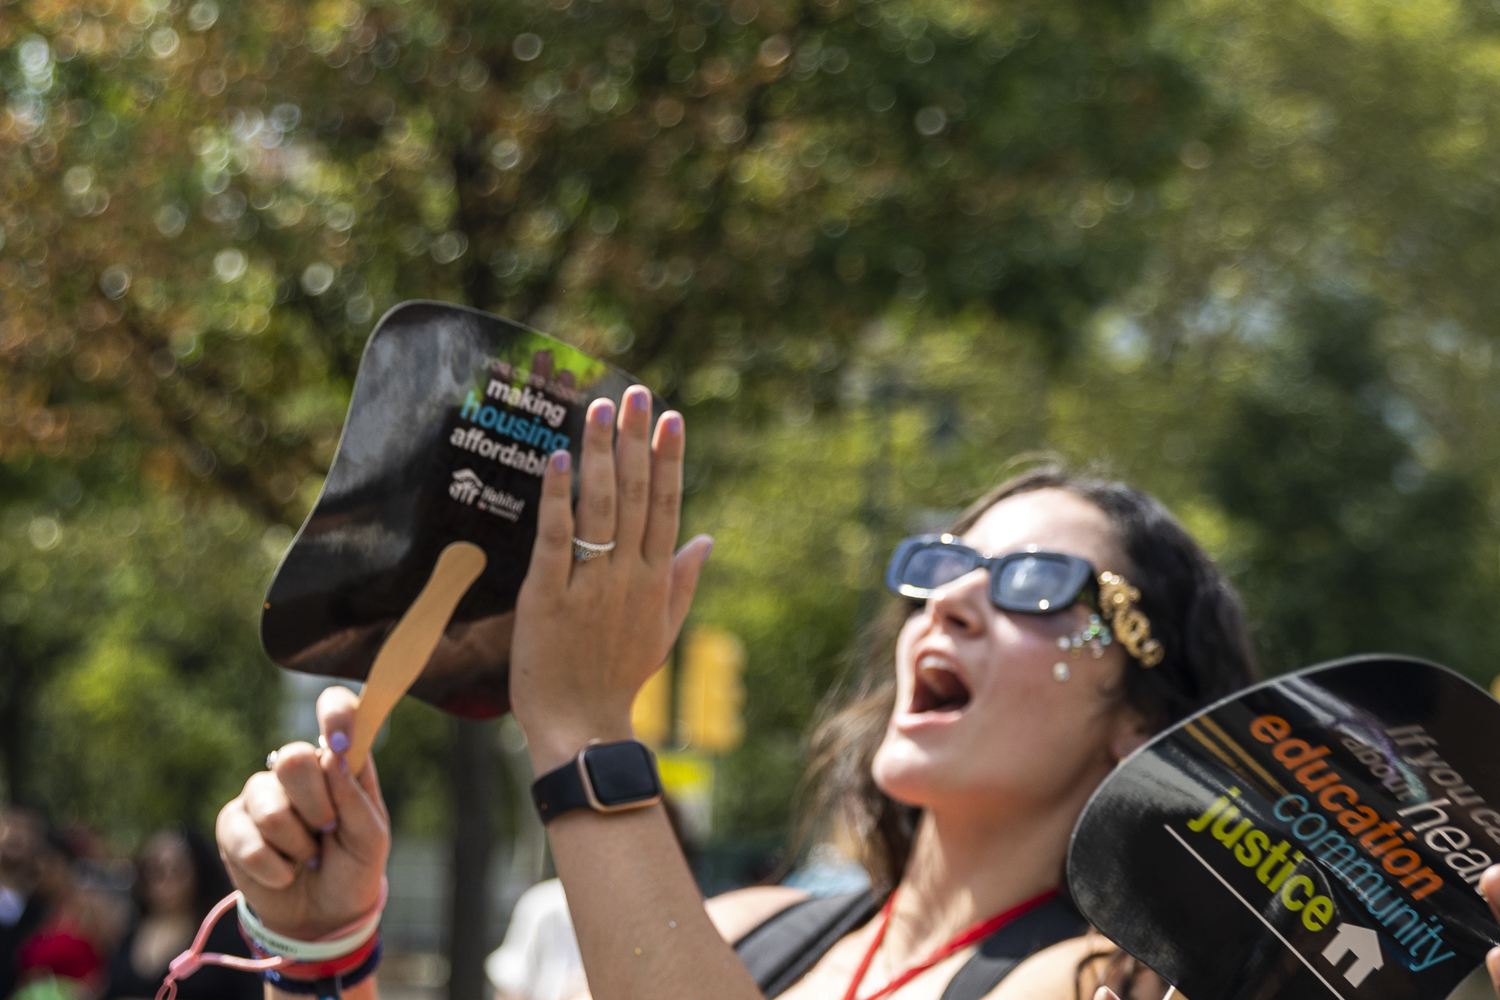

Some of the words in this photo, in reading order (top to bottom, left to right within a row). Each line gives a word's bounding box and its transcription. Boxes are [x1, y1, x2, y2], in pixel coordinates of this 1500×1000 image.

[460, 390, 570, 456] housing
[487, 379, 567, 428] making
[449, 427, 547, 478] affordabl
[1385, 724, 1440, 747] If
[1249, 714, 1443, 901] education
[1401, 751, 1487, 807] you
[1186, 785, 1334, 932] justice
[1272, 793, 1456, 971] community
